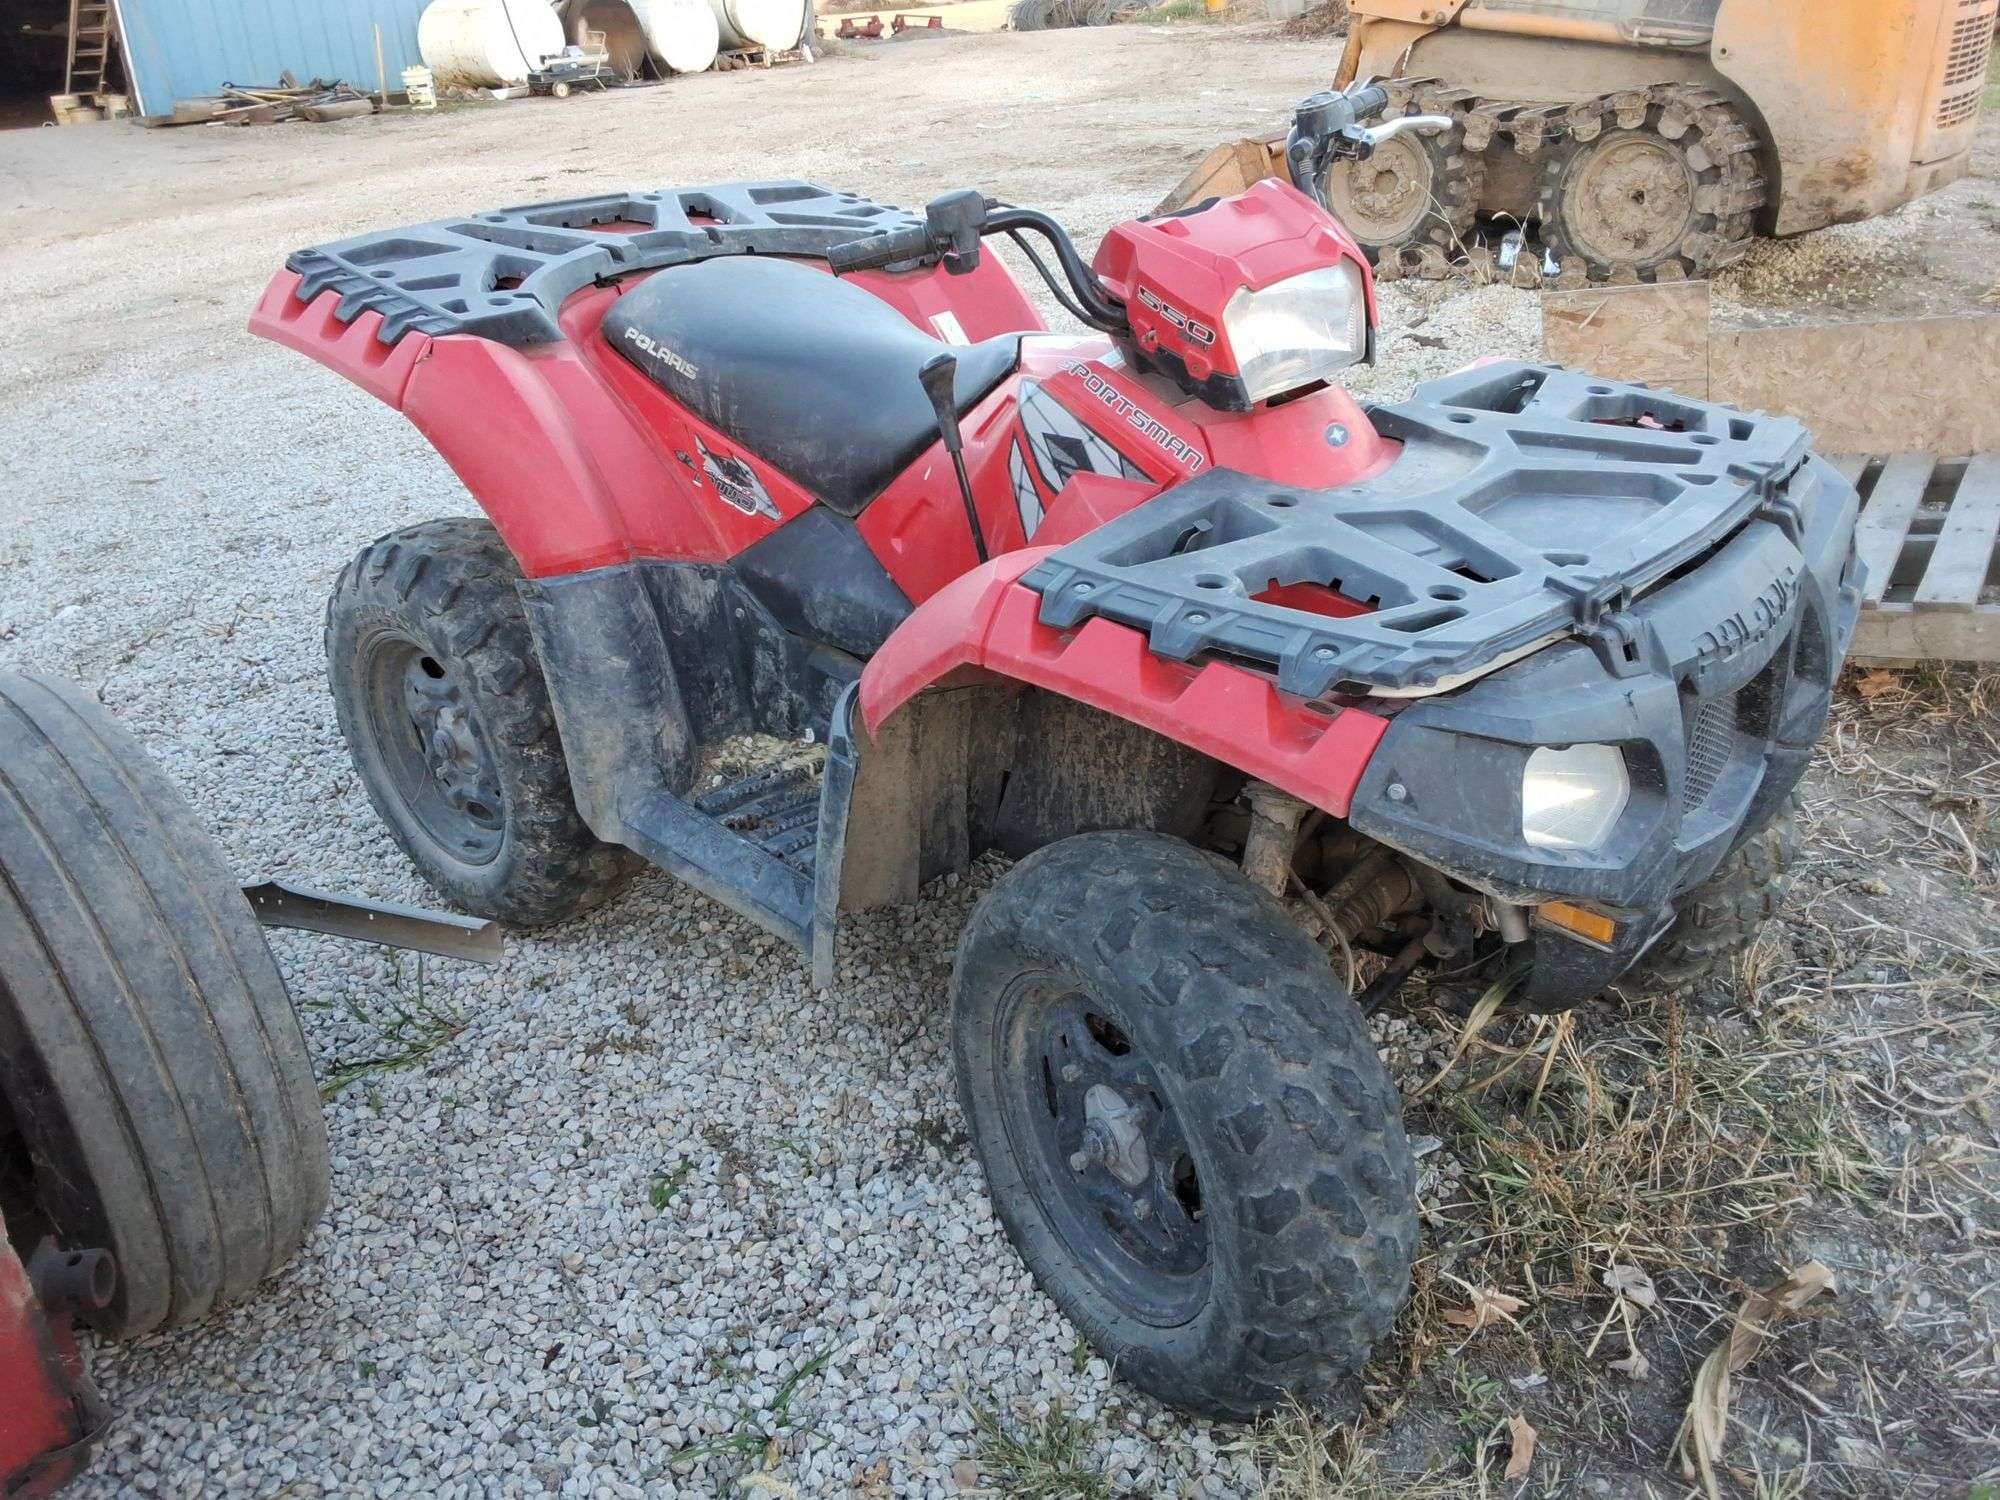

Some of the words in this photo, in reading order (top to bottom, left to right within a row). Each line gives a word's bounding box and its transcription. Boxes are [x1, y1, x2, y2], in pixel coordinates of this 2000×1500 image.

[1137, 284, 1216, 345] 550
[624, 326, 699, 380] POLARIS
[1057, 359, 1205, 472] SPORTSMAN
